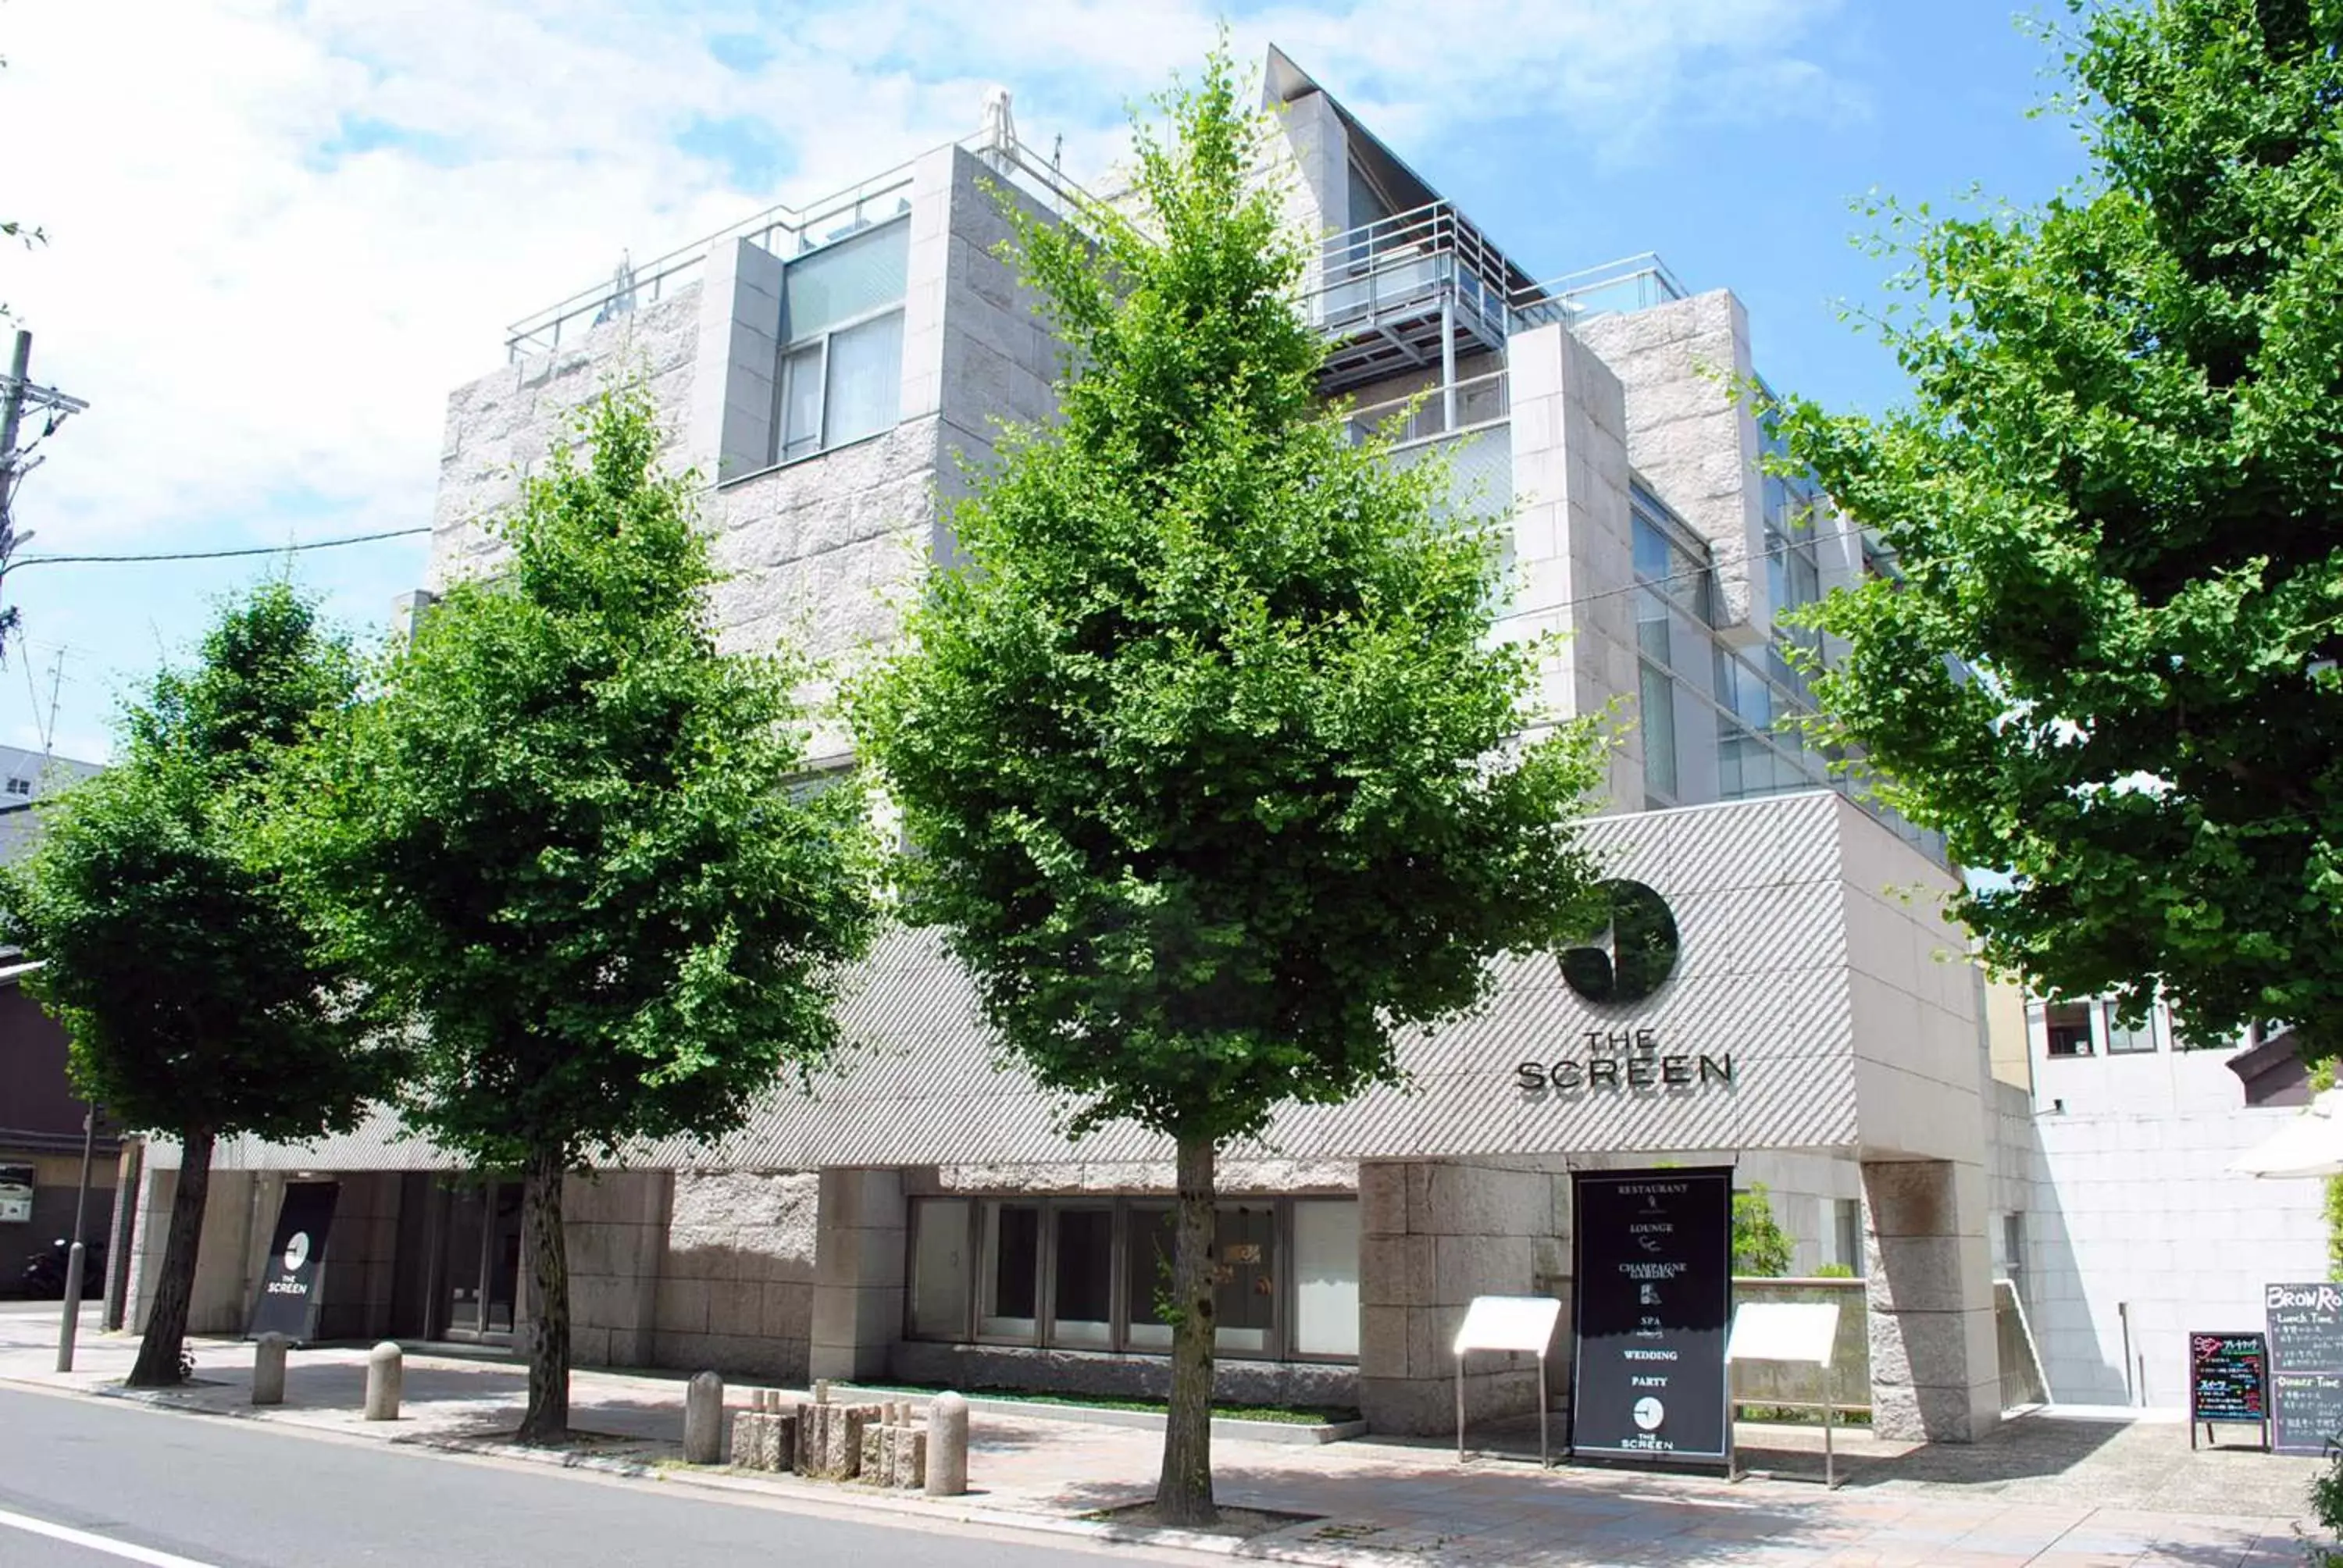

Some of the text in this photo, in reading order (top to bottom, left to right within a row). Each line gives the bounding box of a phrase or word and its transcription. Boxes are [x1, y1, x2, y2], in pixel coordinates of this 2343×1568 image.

[1583, 1028, 1658, 1051] THE
[1517, 1053, 1731, 1089] SCREEN
[1617, 1184, 1689, 1195] RESTAURANT
[1629, 1224, 1674, 1234] LOUNGE
[1618, 1262, 1688, 1273] CHAMPAGNE
[1630, 1269, 1675, 1279] GARDEN
[267, 1282, 308, 1295] SCREEN
[1640, 1316, 1661, 1325] SPA
[1624, 1350, 1678, 1361] WEDDING
[1632, 1376, 1668, 1387] PARTY
[1638, 1433, 1657, 1441] THE
[1621, 1440, 1674, 1450] SCREEN
